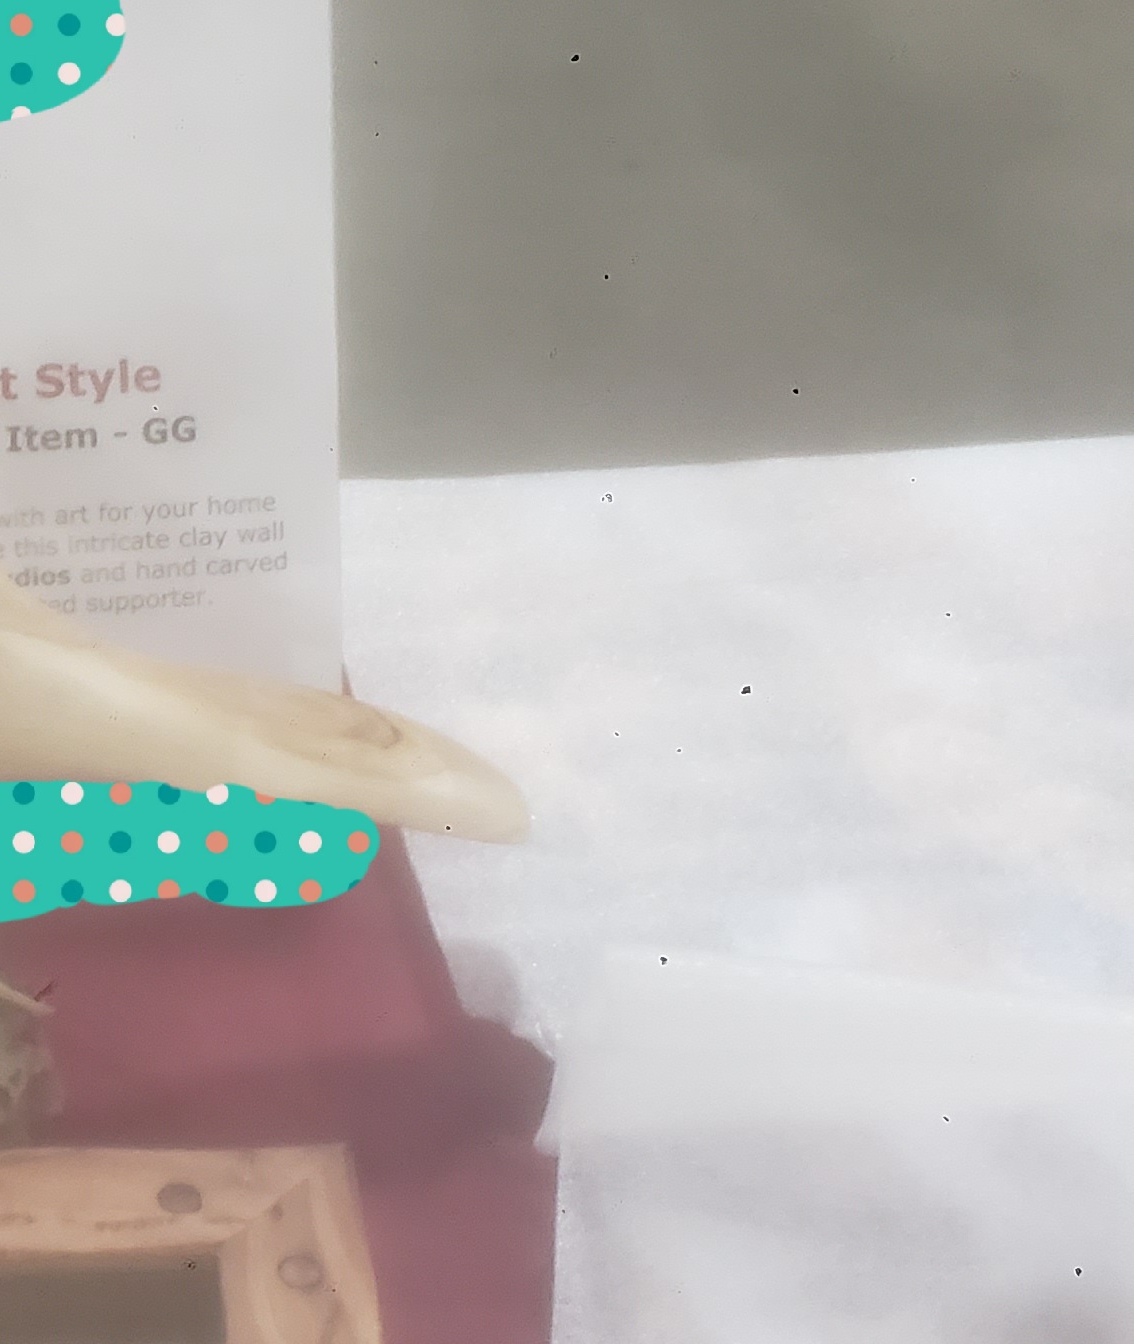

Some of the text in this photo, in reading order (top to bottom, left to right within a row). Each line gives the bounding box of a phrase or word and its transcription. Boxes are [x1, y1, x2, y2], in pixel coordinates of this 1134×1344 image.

[35, 358, 162, 403] Style
[5, 423, 97, 453] Item
[142, 415, 197, 445] GG
[54, 505, 89, 525] art
[99, 502, 134, 522] for
[143, 501, 199, 526] your
[208, 495, 277, 516] home
[15, 536, 59, 558] this
[69, 531, 170, 554] intricate
[179, 526, 228, 550] clay
[237, 521, 284, 543] wall
[8, 551, 288, 587] dios and hand carved
[86, 588, 214, 615] supporter.
